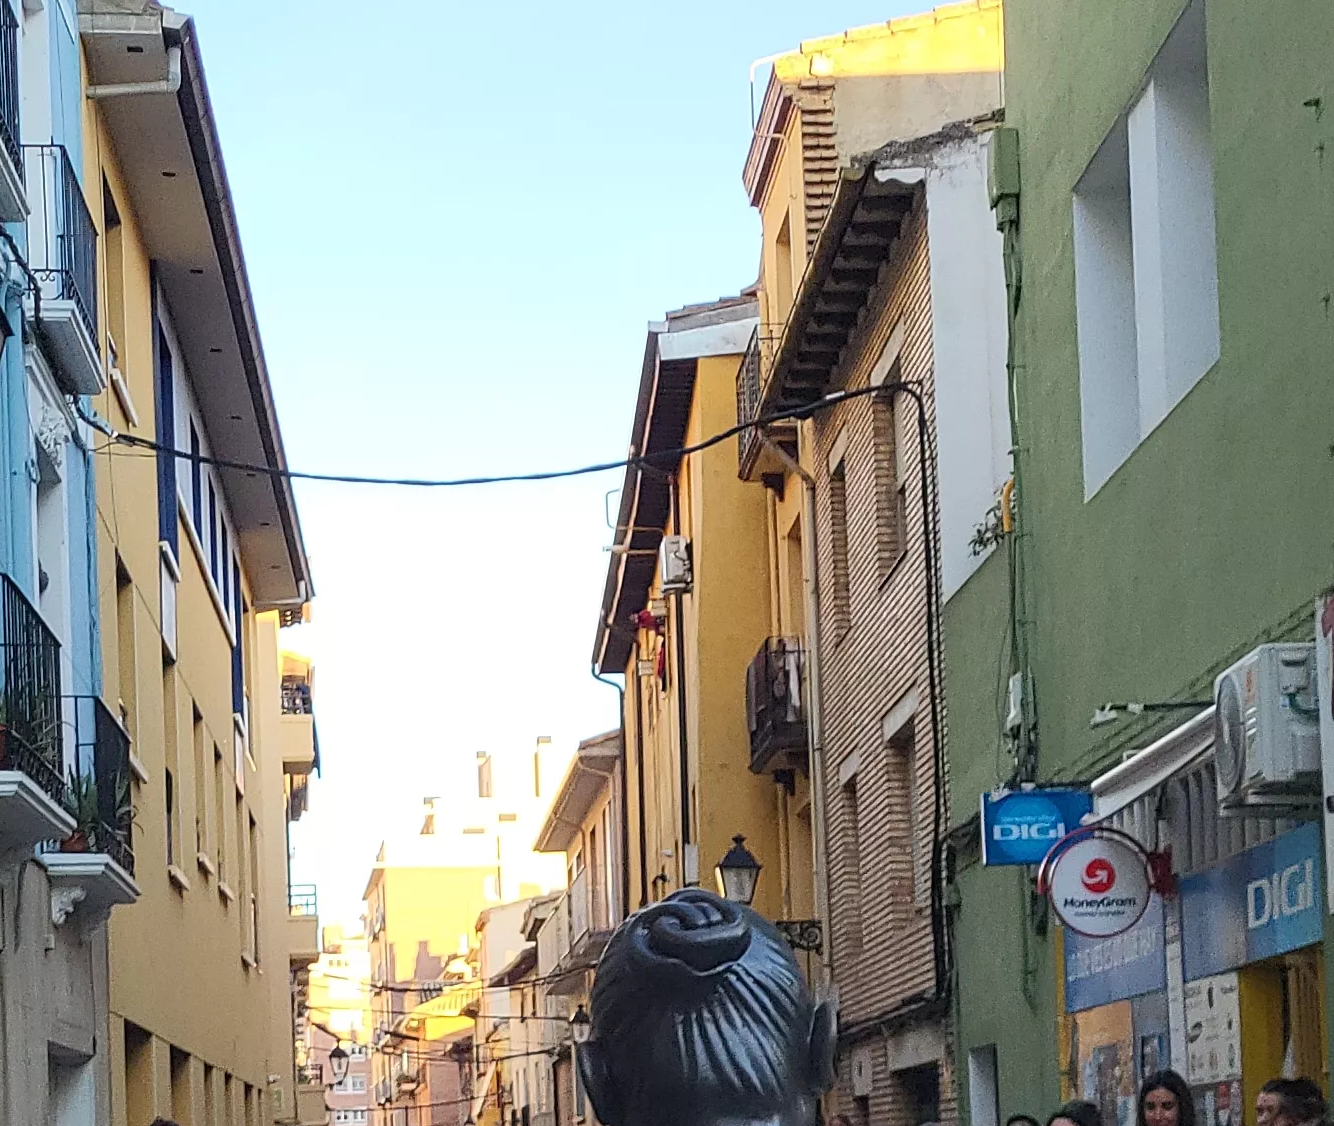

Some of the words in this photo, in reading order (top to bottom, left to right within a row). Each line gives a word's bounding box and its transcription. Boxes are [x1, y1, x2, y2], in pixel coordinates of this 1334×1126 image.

[993, 822, 1066, 840] DIGI
[1063, 896, 1136, 910] MoneyGram
[1248, 858, 1314, 930] DIGI
